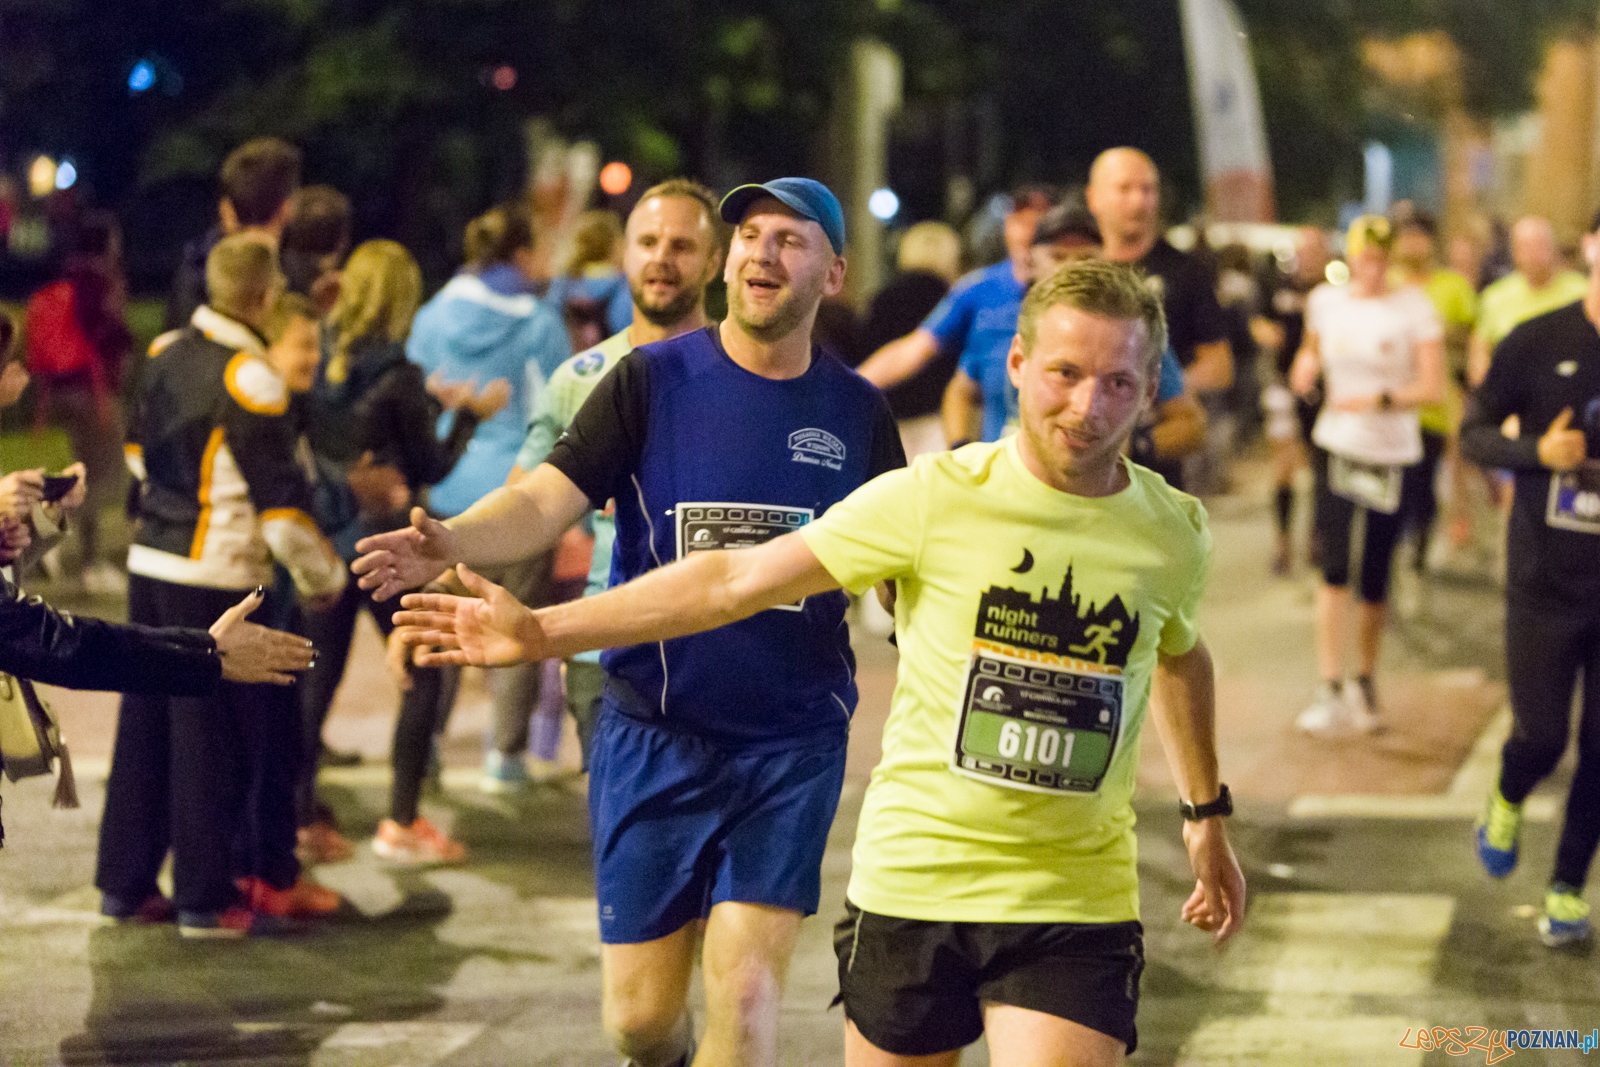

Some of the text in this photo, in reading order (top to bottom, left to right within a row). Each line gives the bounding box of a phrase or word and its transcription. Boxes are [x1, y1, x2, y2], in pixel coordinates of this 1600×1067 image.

[987, 603, 1038, 628] night
[984, 621, 1059, 648] runners
[998, 720, 1075, 768] 6101
